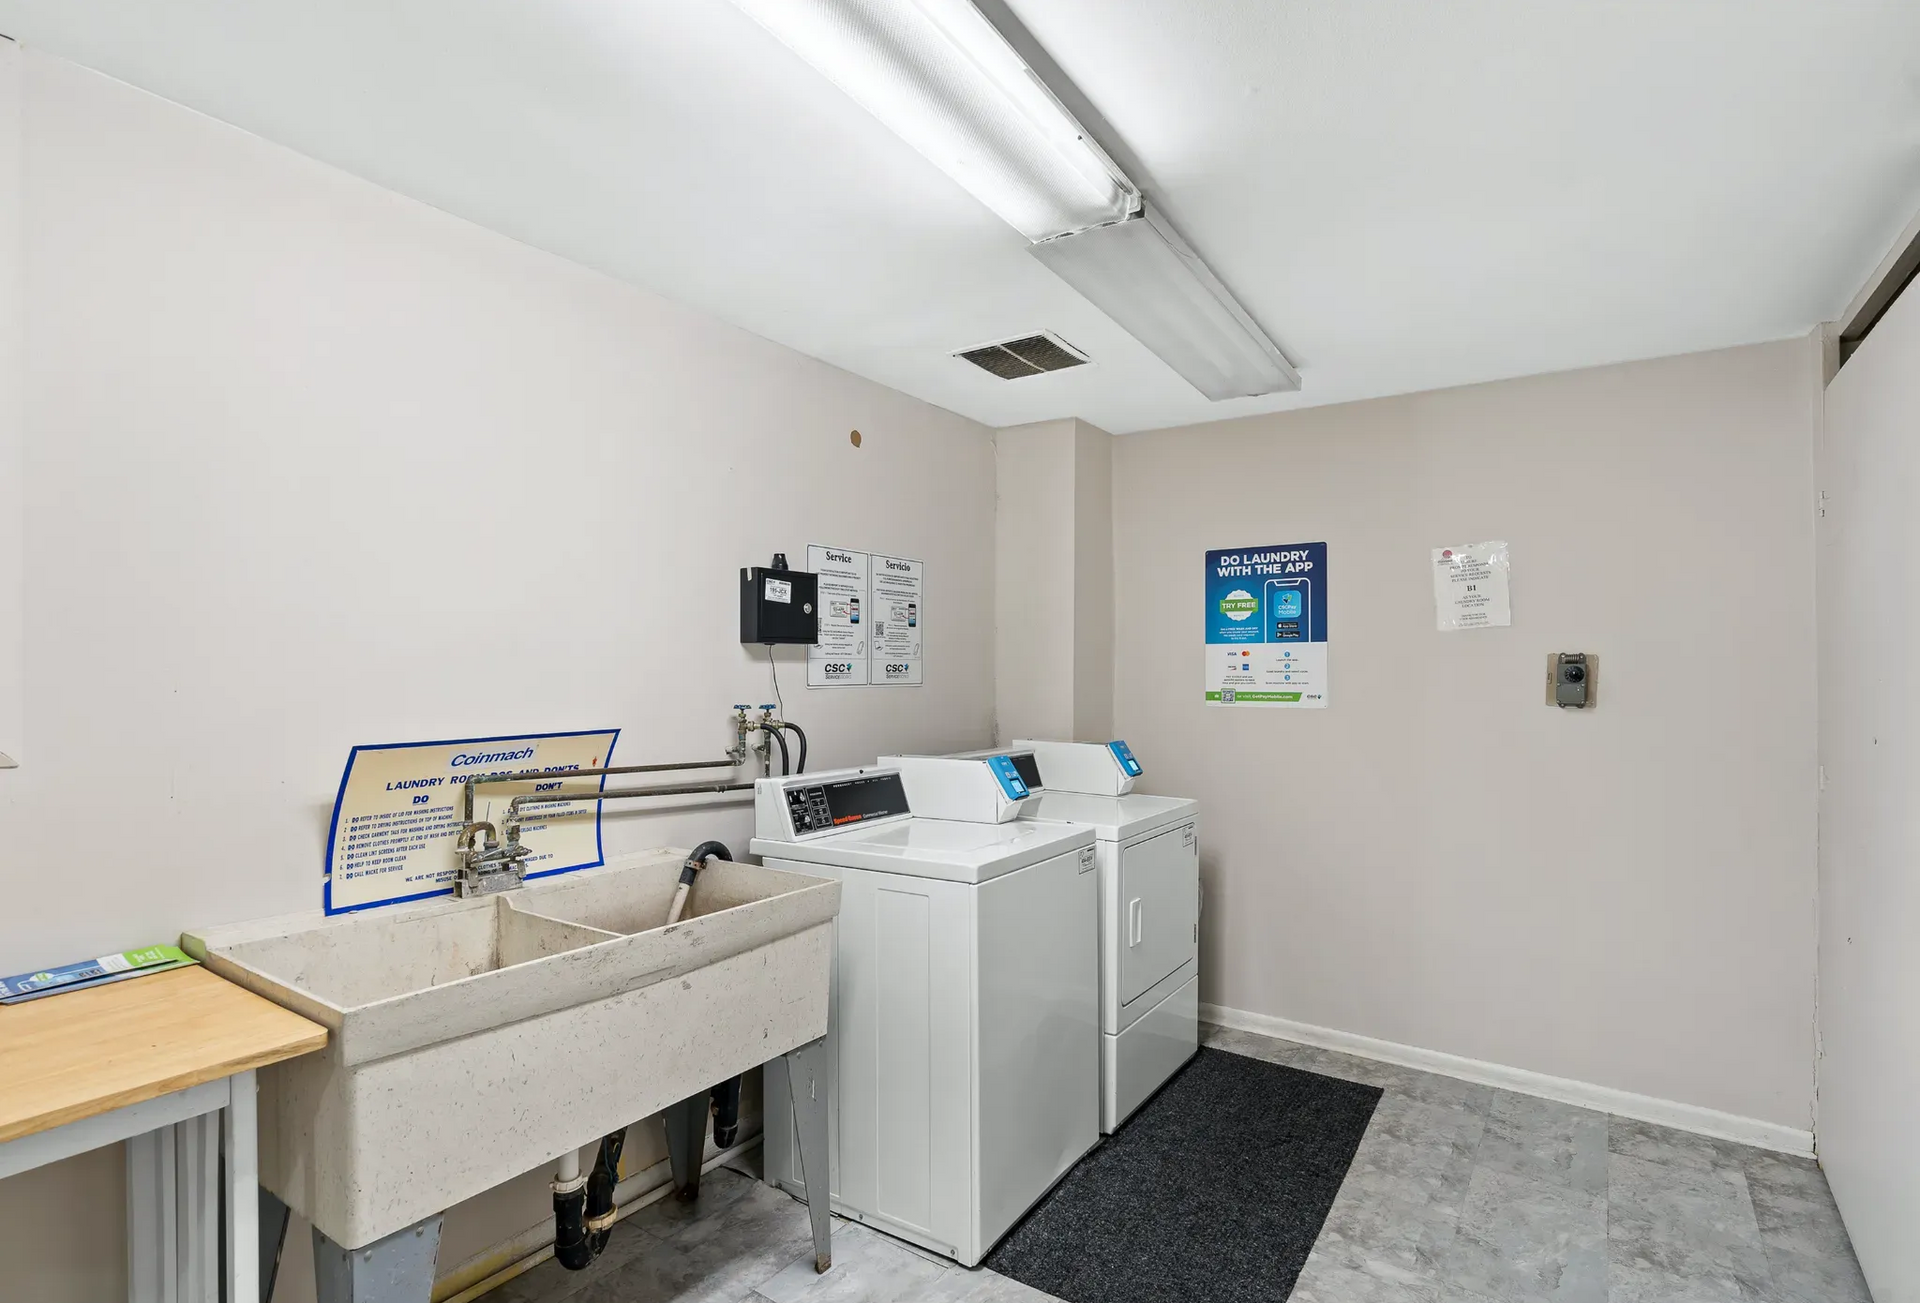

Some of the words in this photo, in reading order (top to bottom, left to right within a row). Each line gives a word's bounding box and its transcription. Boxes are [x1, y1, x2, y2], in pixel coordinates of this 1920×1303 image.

[826, 551, 852, 563] Service
[1220, 555, 1240, 566] DO
[1243, 550, 1309, 564] LAUNDRY
[886, 560, 911, 572] Servicio
[1217, 565, 1251, 577] WITH
[1254, 564, 1282, 575] THE
[1284, 562, 1313, 573] APP
[1237, 601, 1256, 609] FREE
[824, 663, 846, 673] CSC
[885, 663, 904, 673] CSC
[451, 747, 534, 767] Coinmach
[386, 776, 446, 792] LAUNDRY
[535, 782, 563, 792] DON'T
[412, 795, 429, 805] DO
